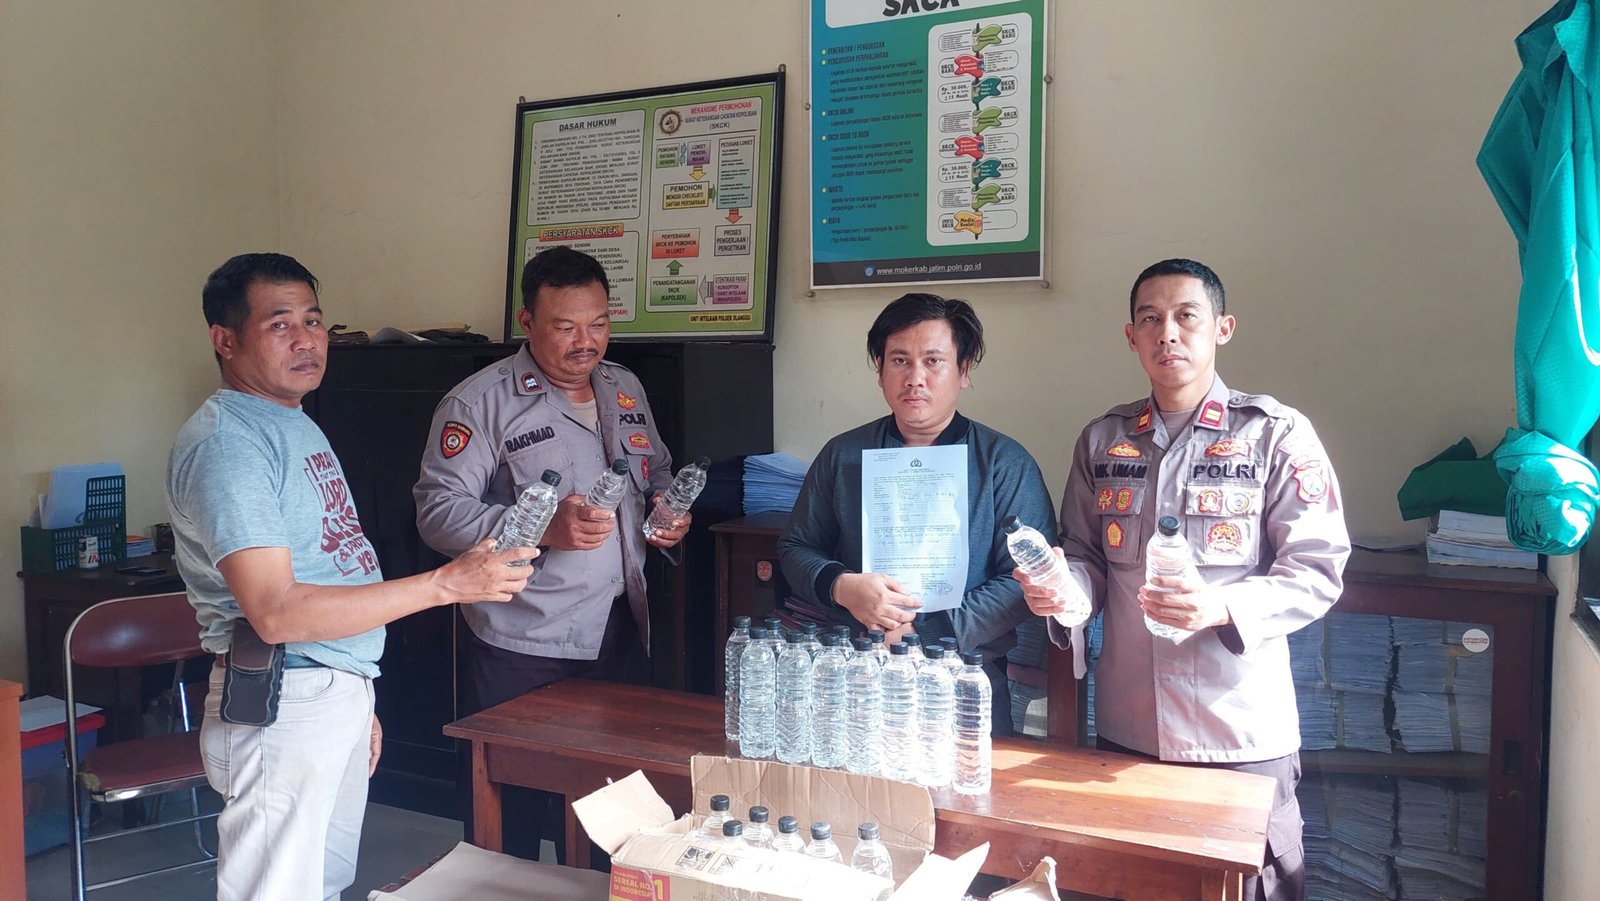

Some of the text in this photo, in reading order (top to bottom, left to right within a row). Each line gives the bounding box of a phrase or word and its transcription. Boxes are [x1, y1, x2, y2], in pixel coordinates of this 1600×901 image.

[690, 101, 752, 114] MEKANISME PERMOHONAN
[559, 118, 617, 131] DASAR HUKUM
[709, 122, 731, 131] (SKCK)
[669, 184, 703, 192] PEMOHON
[543, 225, 620, 239] PERSYARATAN SKCK
[723, 228, 742, 236] PROSES
[716, 236, 746, 245] PENGERJAAN
[717, 244, 747, 252] PENGETIKAN
[619, 412, 647, 426] POLRI
[504, 425, 555, 453] RAKHMAD
[1193, 462, 1257, 479] POLRI
[613, 875, 640, 888] SEREAL
[620, 886, 652, 897] INDONESIA
